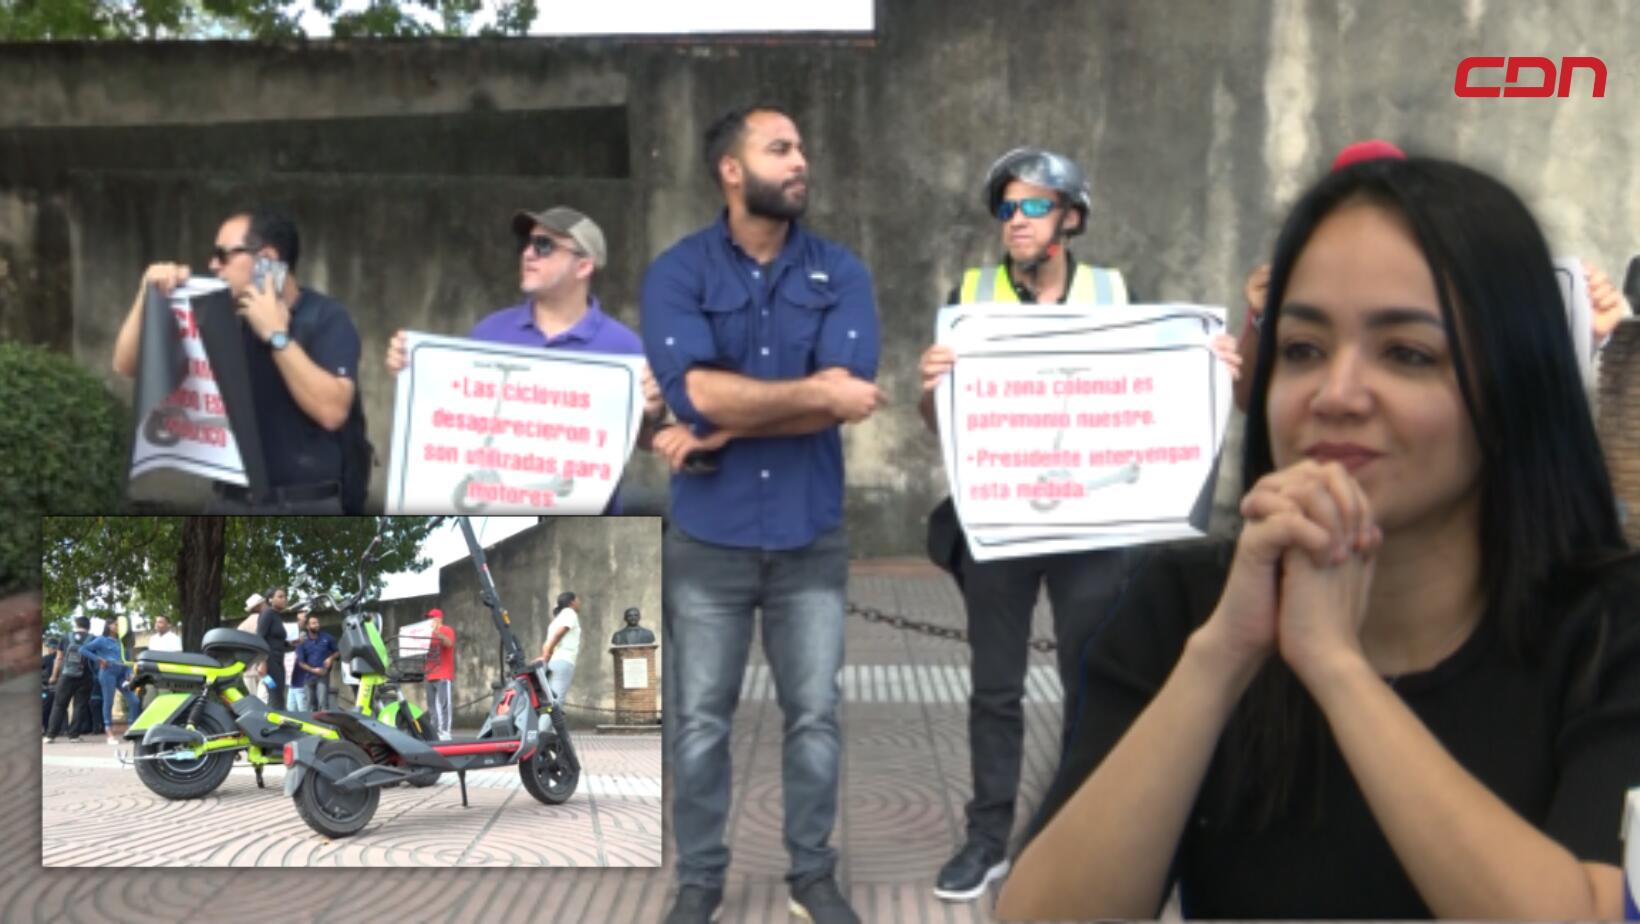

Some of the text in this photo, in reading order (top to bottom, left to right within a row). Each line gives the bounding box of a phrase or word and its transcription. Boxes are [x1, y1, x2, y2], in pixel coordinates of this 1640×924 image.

[1004, 379, 1046, 397] zona
[1053, 376, 1127, 396] colonial
[1132, 376, 1153, 393] es
[424, 443, 458, 464] son
[563, 459, 611, 480] para
